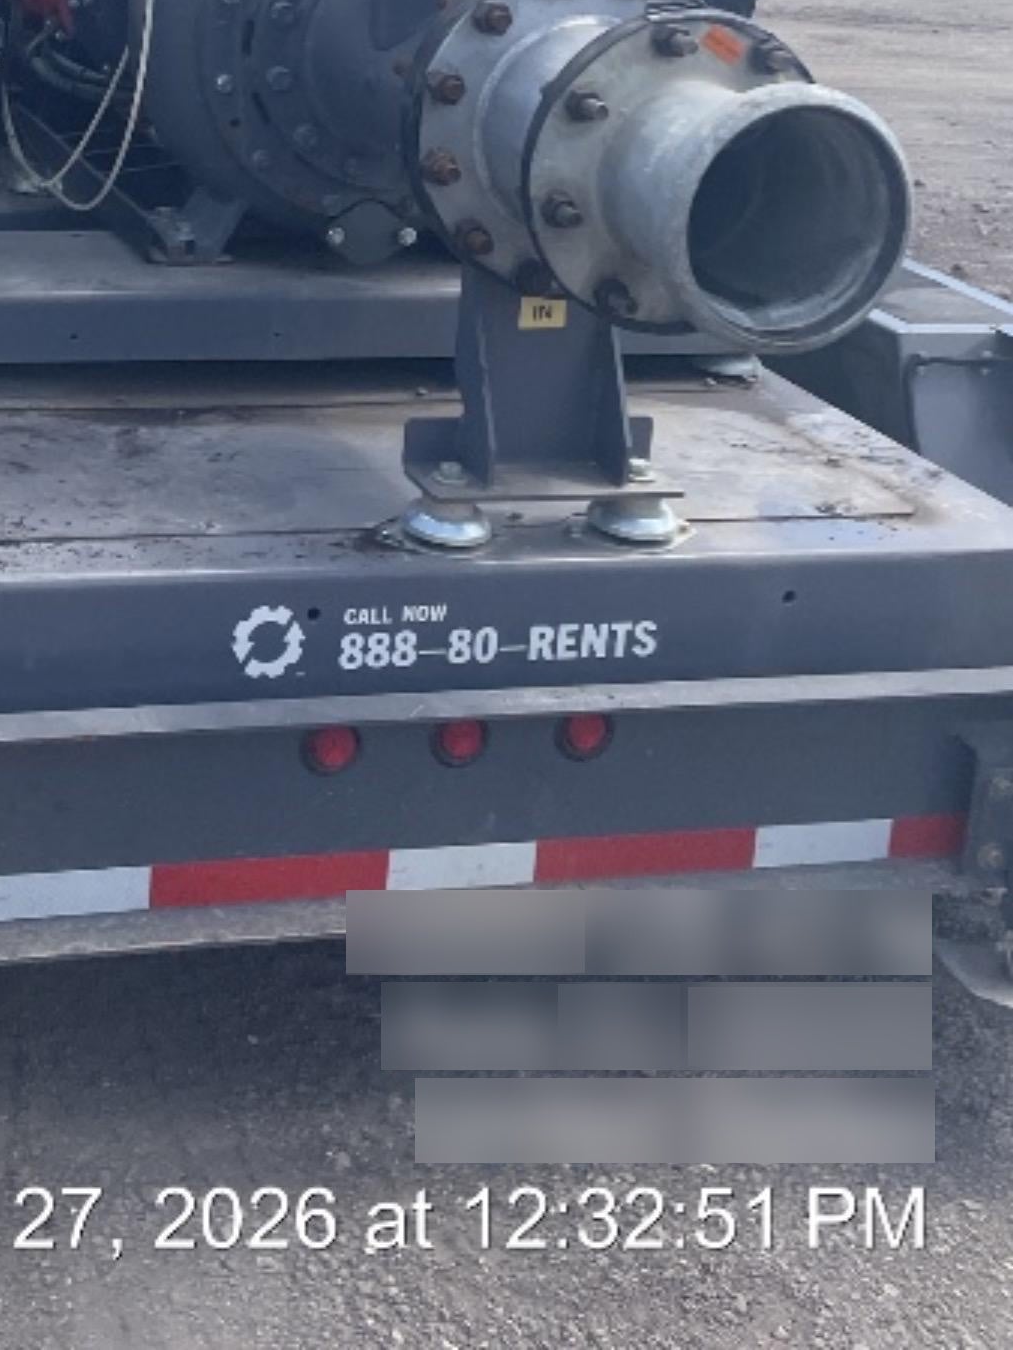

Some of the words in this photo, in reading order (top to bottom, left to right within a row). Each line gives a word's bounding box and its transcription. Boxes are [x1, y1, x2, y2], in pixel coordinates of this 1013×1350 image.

[343, 607, 392, 626] CALL
[401, 604, 448, 623] NOW
[338, 620, 658, 670] 888-80-RENTS
